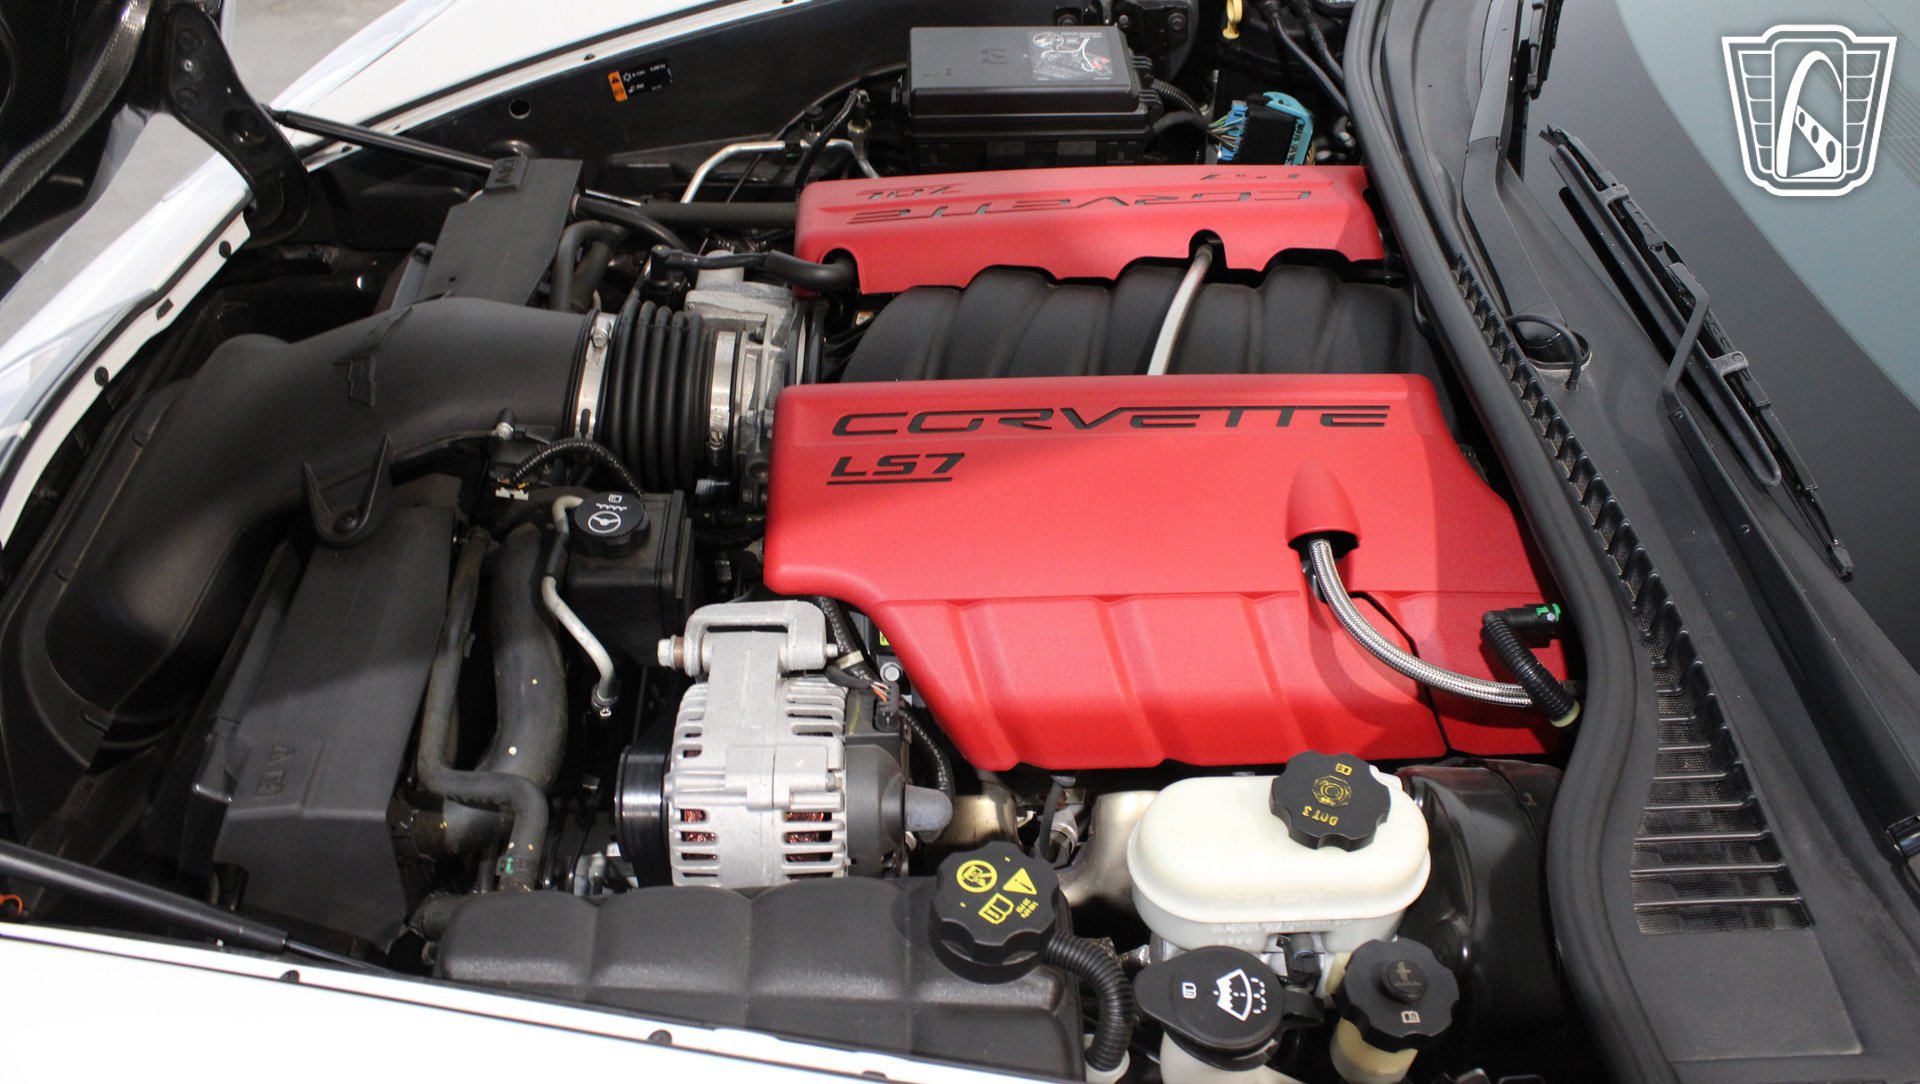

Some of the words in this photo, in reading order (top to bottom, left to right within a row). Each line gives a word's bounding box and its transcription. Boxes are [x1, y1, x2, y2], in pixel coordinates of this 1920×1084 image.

[846, 191, 1312, 225] CORVETTE
[831, 405, 1391, 437] CORVETTE
[830, 452, 966, 478] LS7
[1301, 805, 1313, 817] 3
[1311, 809, 1339, 827] DOT
